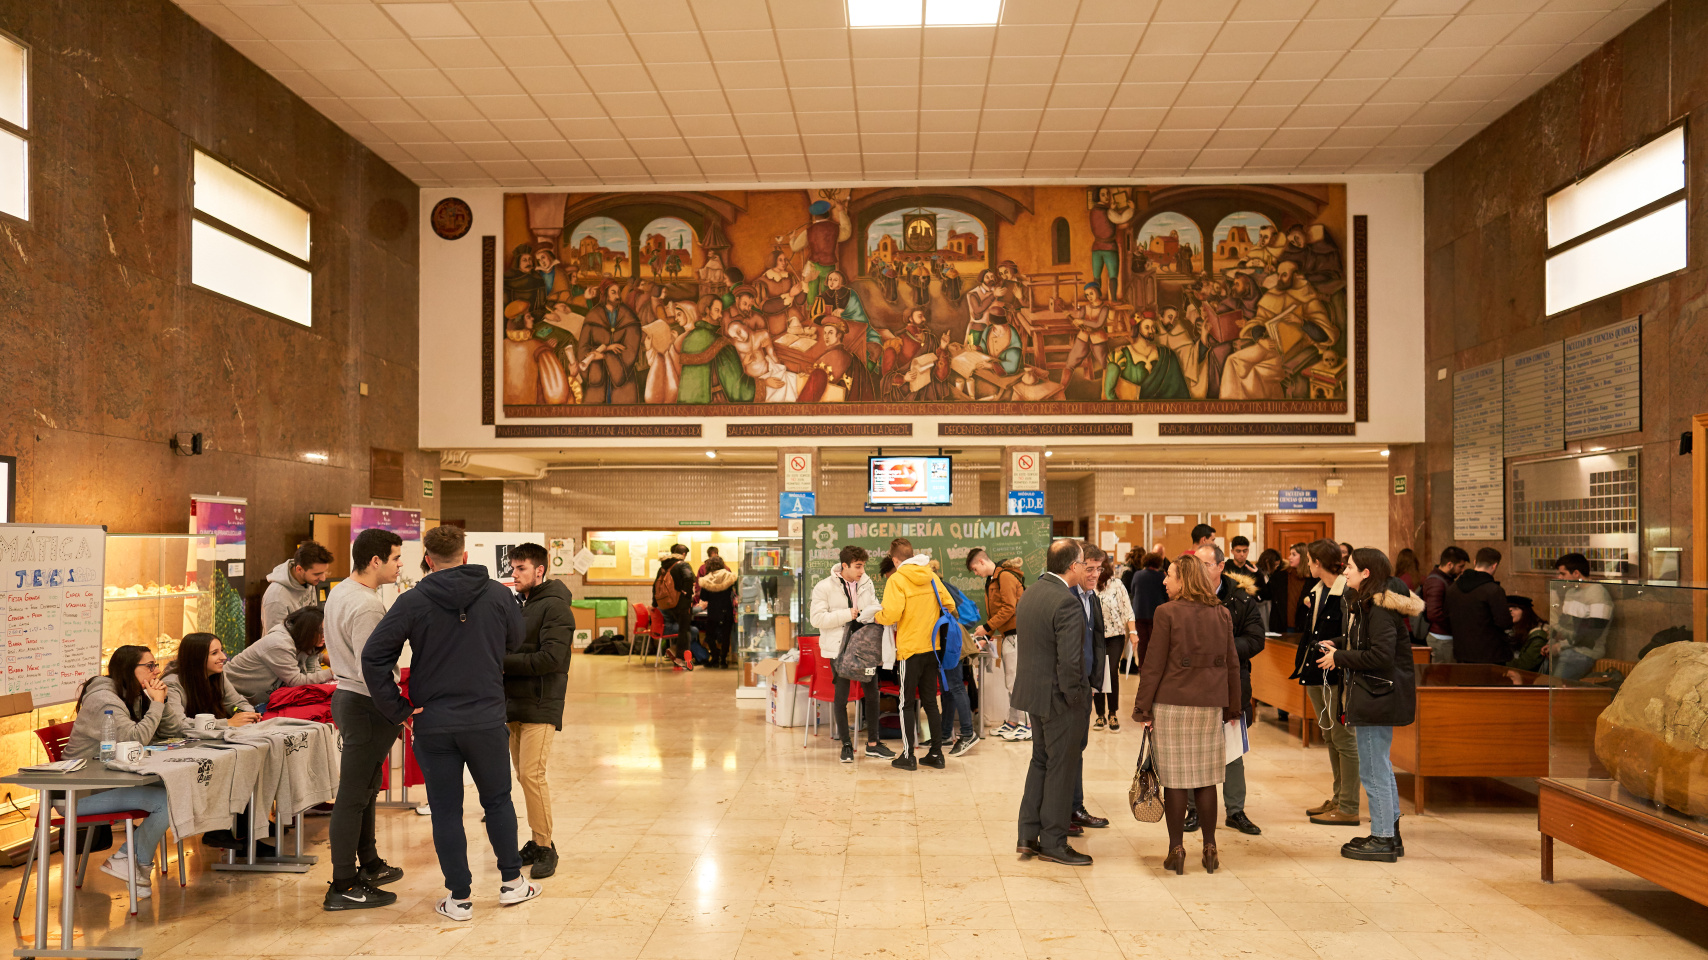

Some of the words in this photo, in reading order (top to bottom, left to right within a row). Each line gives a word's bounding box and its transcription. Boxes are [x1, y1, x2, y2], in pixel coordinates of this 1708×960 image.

[792, 498, 803, 511] A
[847, 518, 944, 538] INGENIERÍA
[950, 518, 1021, 540] QUÍMICA
